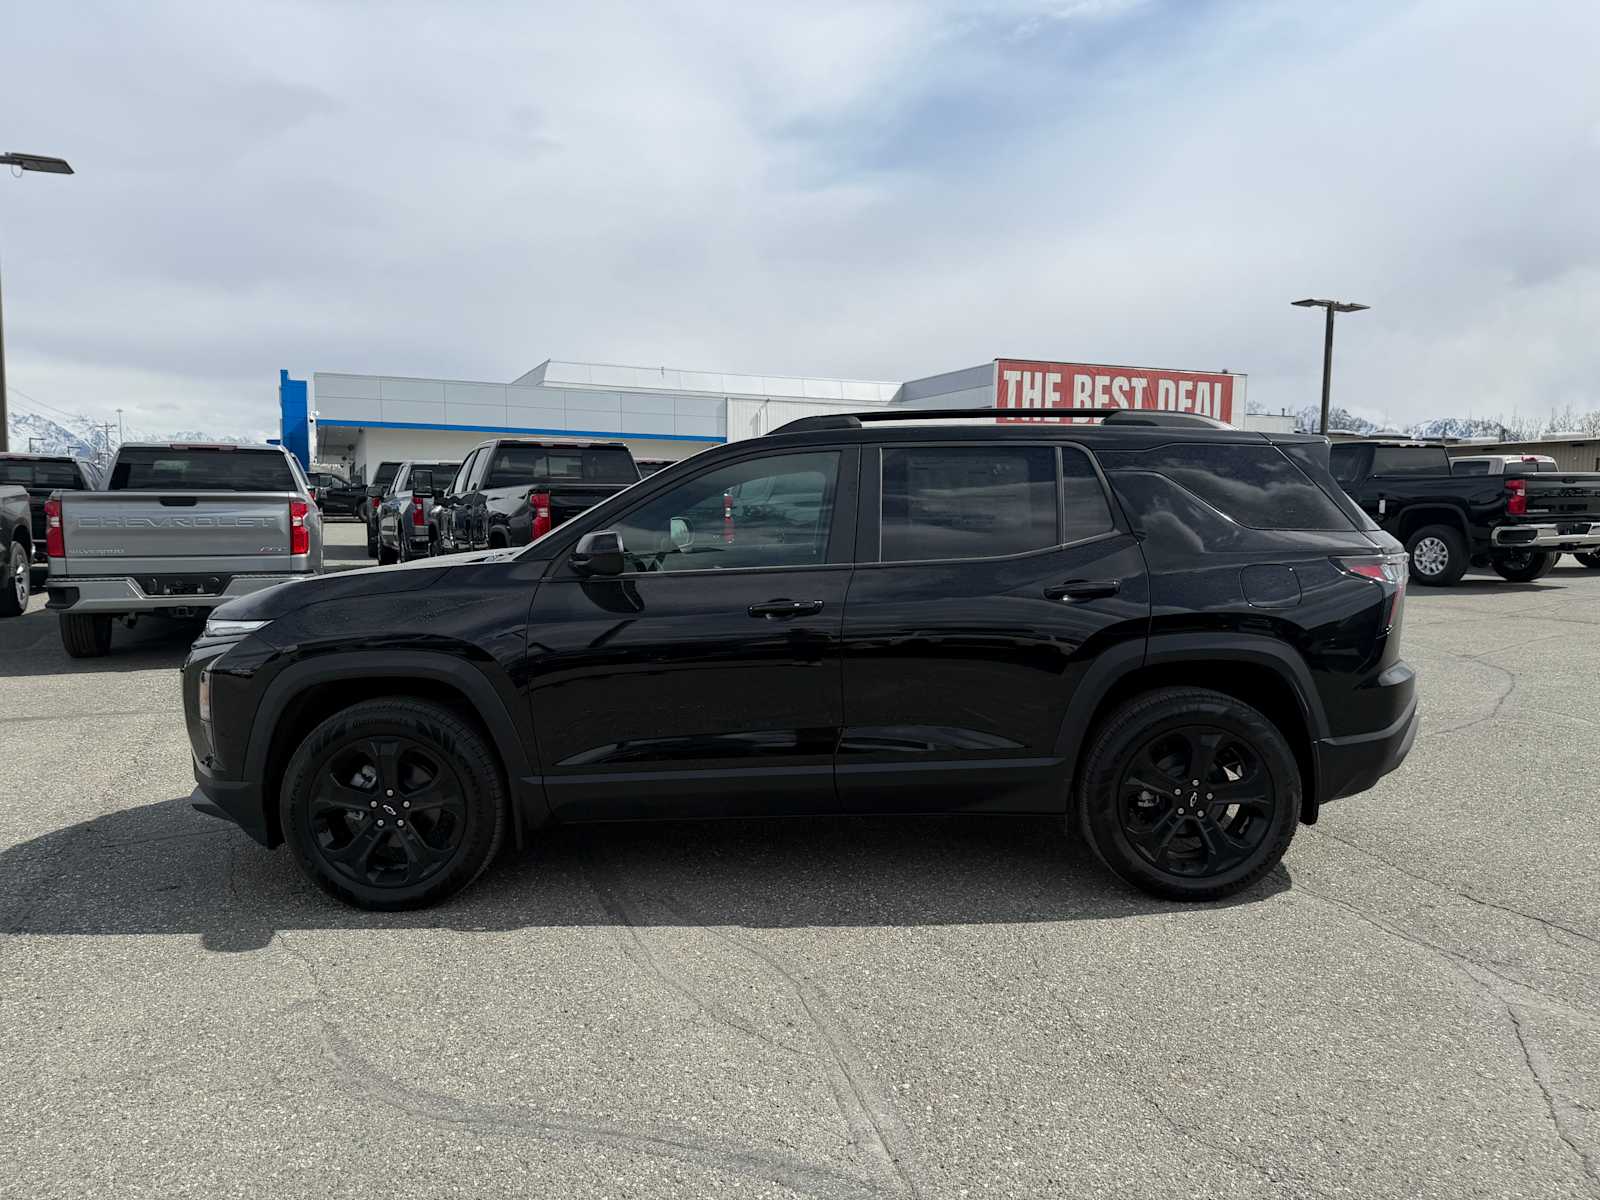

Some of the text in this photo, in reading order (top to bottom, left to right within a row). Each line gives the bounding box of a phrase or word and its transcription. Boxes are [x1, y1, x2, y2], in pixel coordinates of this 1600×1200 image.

[1004, 370, 1062, 422] THE
[1073, 374, 1147, 423] BEST
[78, 516, 276, 529] CHEVROLET
